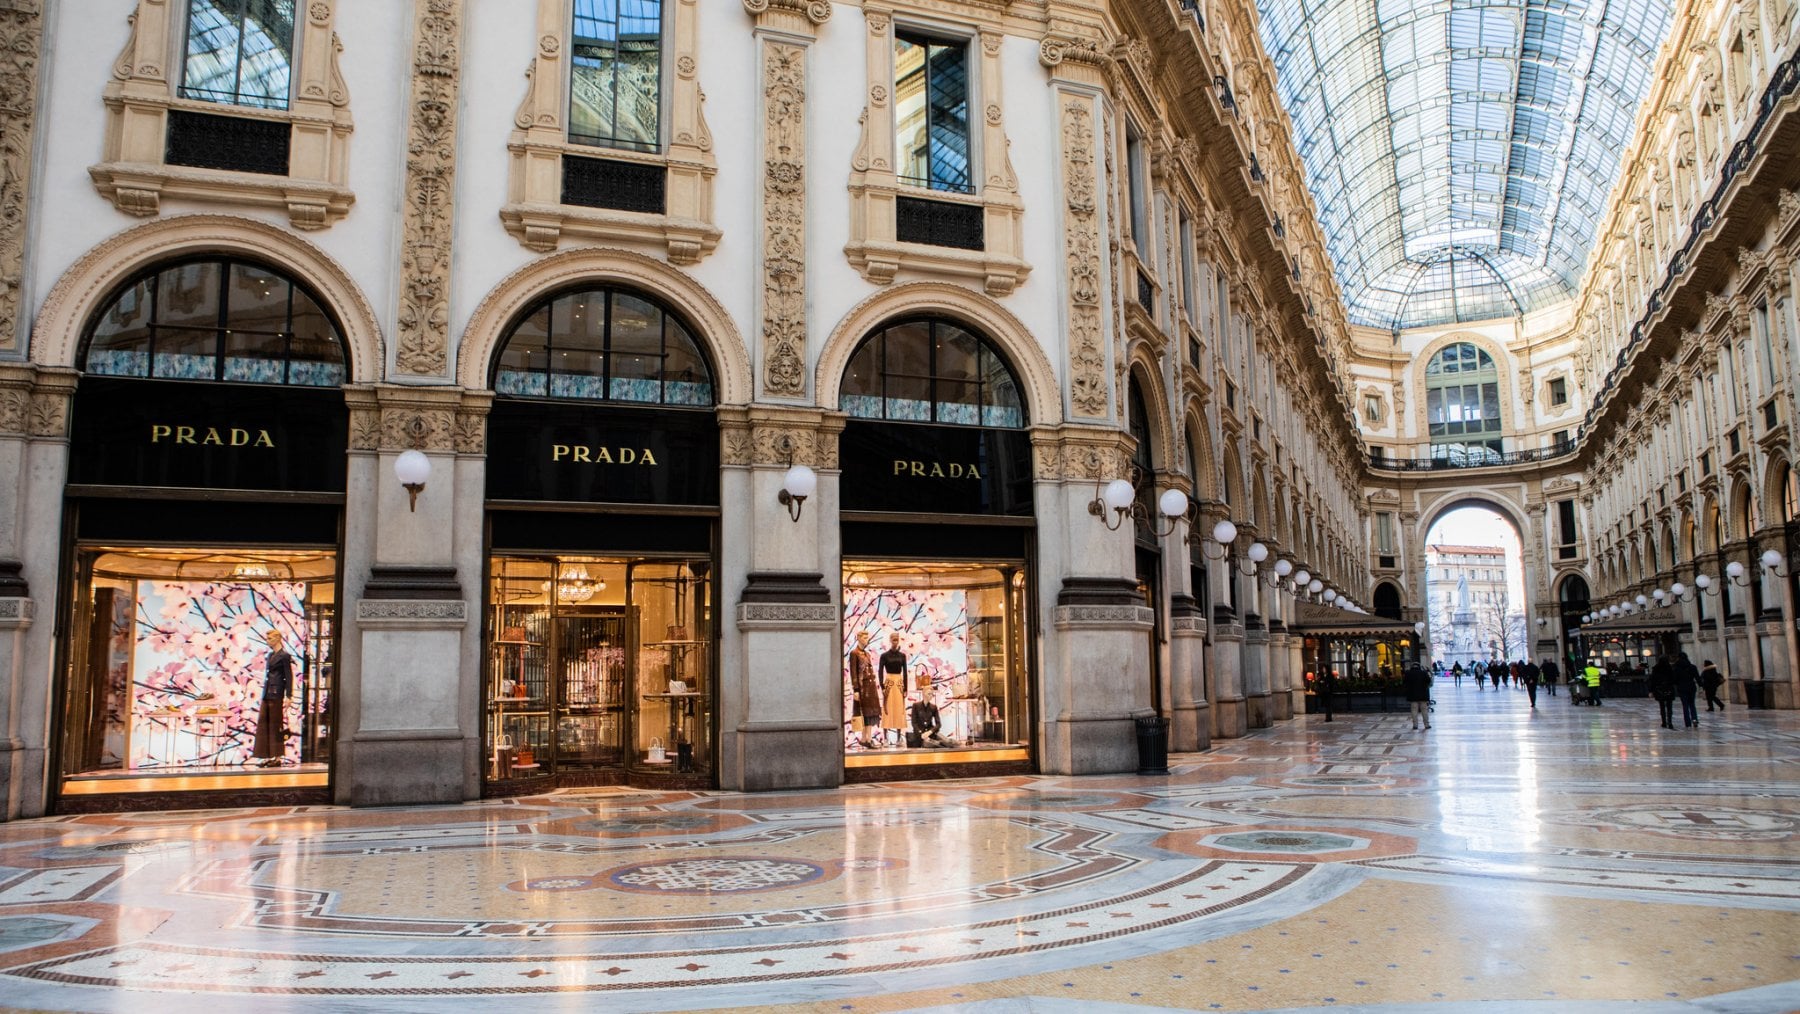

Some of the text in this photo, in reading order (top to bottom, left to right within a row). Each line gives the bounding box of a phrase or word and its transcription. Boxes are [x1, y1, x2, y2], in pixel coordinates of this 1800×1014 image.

[152, 425, 275, 447] PRADA
[552, 444, 658, 466] PRADA
[893, 460, 982, 479] PRADA
